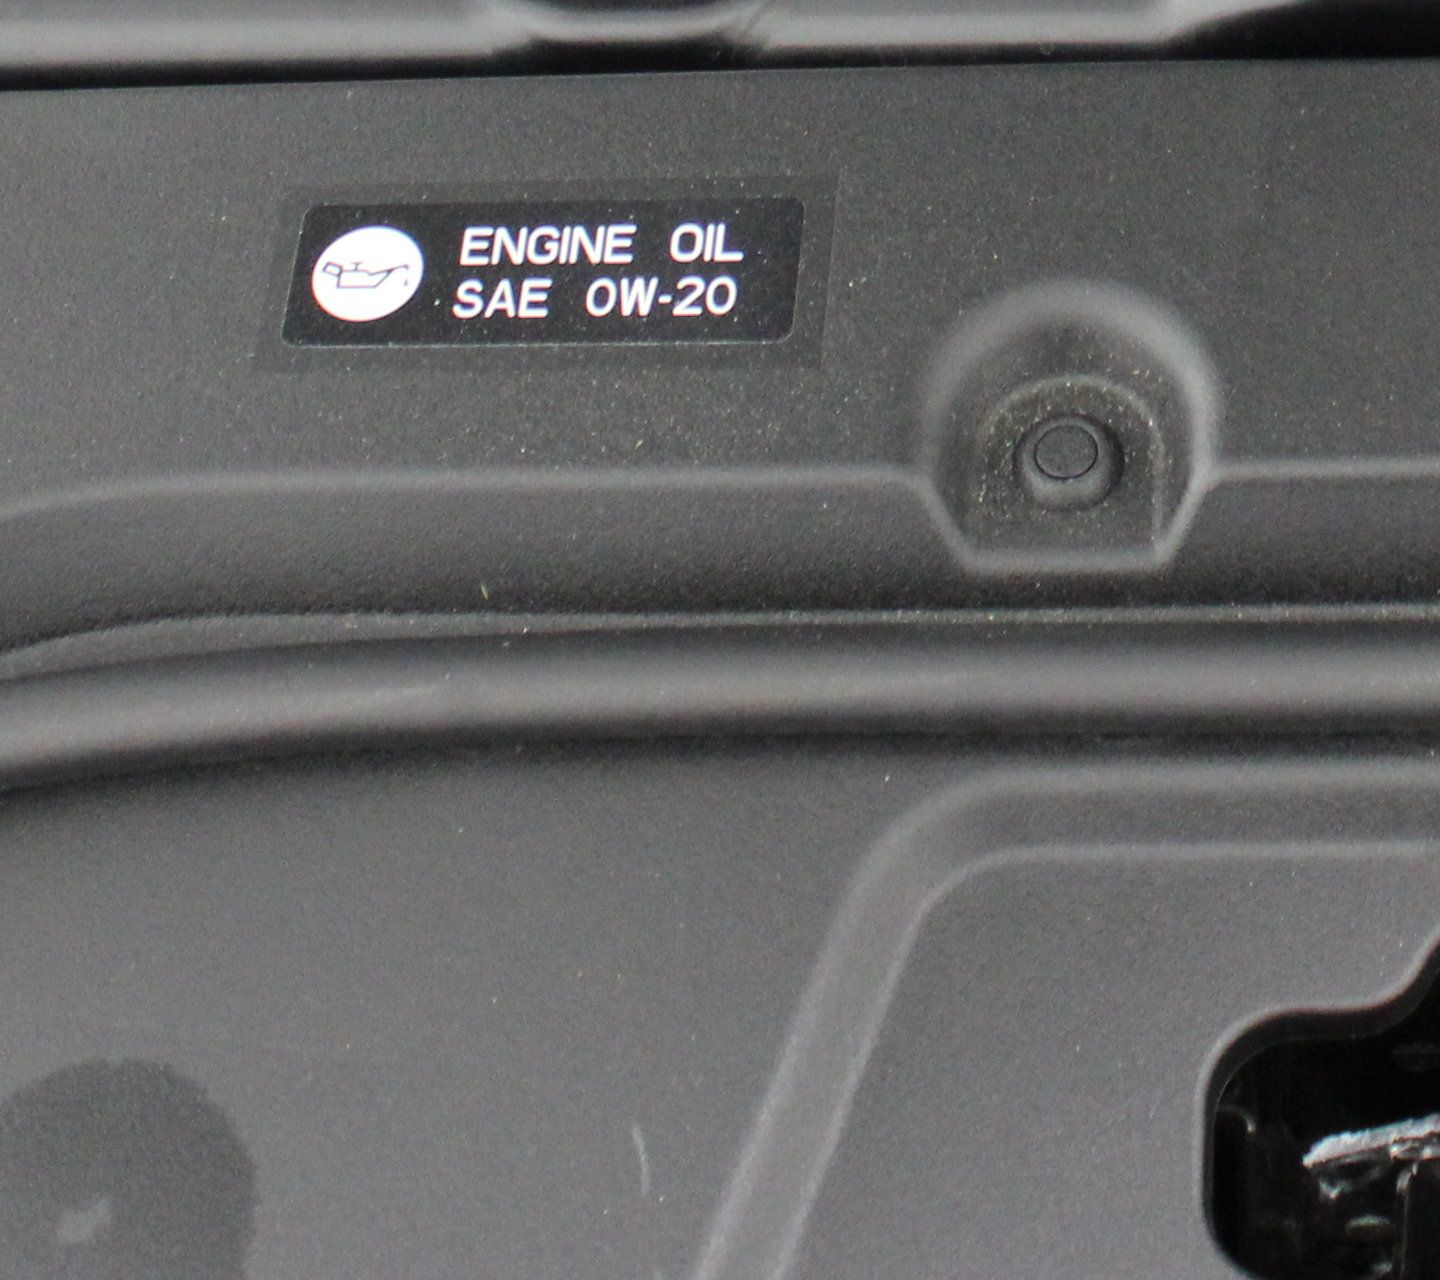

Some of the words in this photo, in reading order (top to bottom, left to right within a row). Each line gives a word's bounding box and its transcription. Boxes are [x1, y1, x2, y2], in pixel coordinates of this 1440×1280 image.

[458, 223, 636, 267] ENGINE
[669, 221, 744, 263] OIL
[451, 277, 551, 320] SAE
[585, 274, 739, 319] 0W-20
